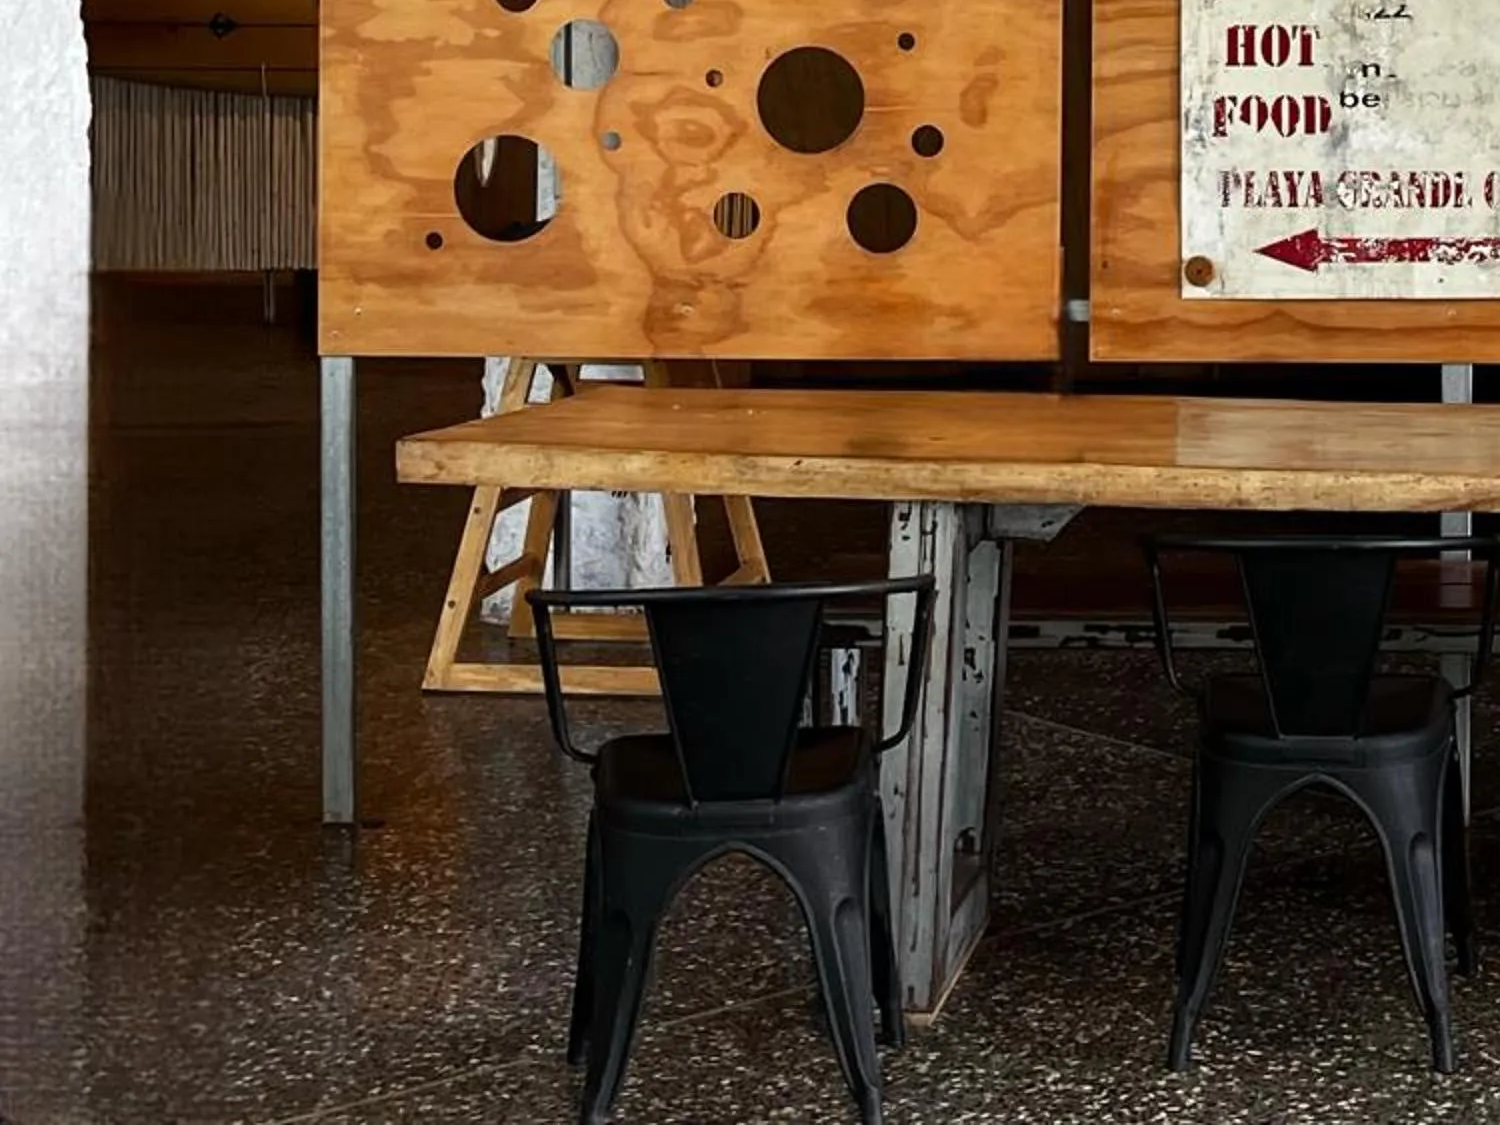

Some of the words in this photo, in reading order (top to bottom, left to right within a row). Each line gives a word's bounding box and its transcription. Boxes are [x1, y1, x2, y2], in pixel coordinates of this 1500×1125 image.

[1225, 24, 1321, 67] HOT
[1212, 94, 1333, 139] FOOD
[1217, 169, 1324, 209] PLAYA
